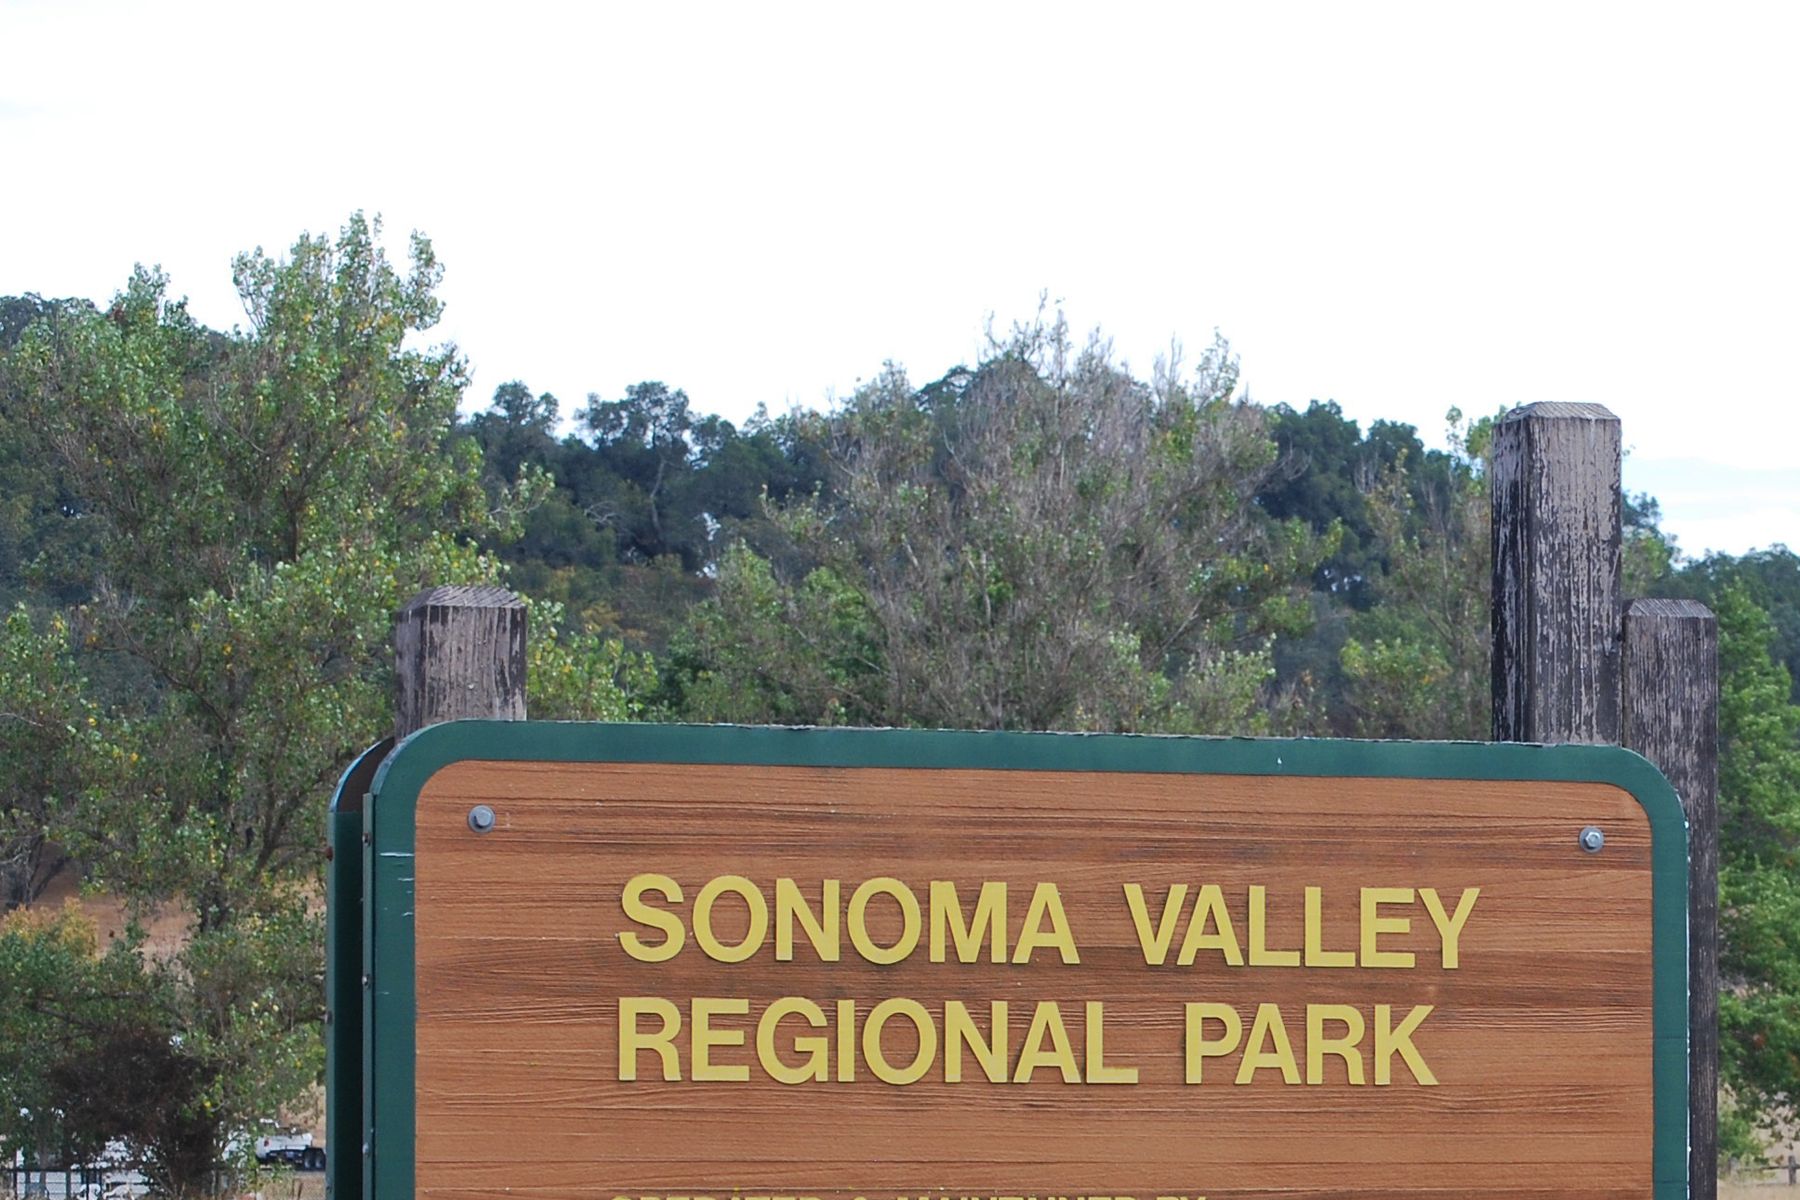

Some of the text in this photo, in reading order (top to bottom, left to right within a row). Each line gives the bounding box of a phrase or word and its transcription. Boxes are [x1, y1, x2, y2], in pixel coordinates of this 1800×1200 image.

[617, 872, 1481, 969] SONOMA VALLEY
[618, 996, 1441, 1086] REGIONAL PARK
